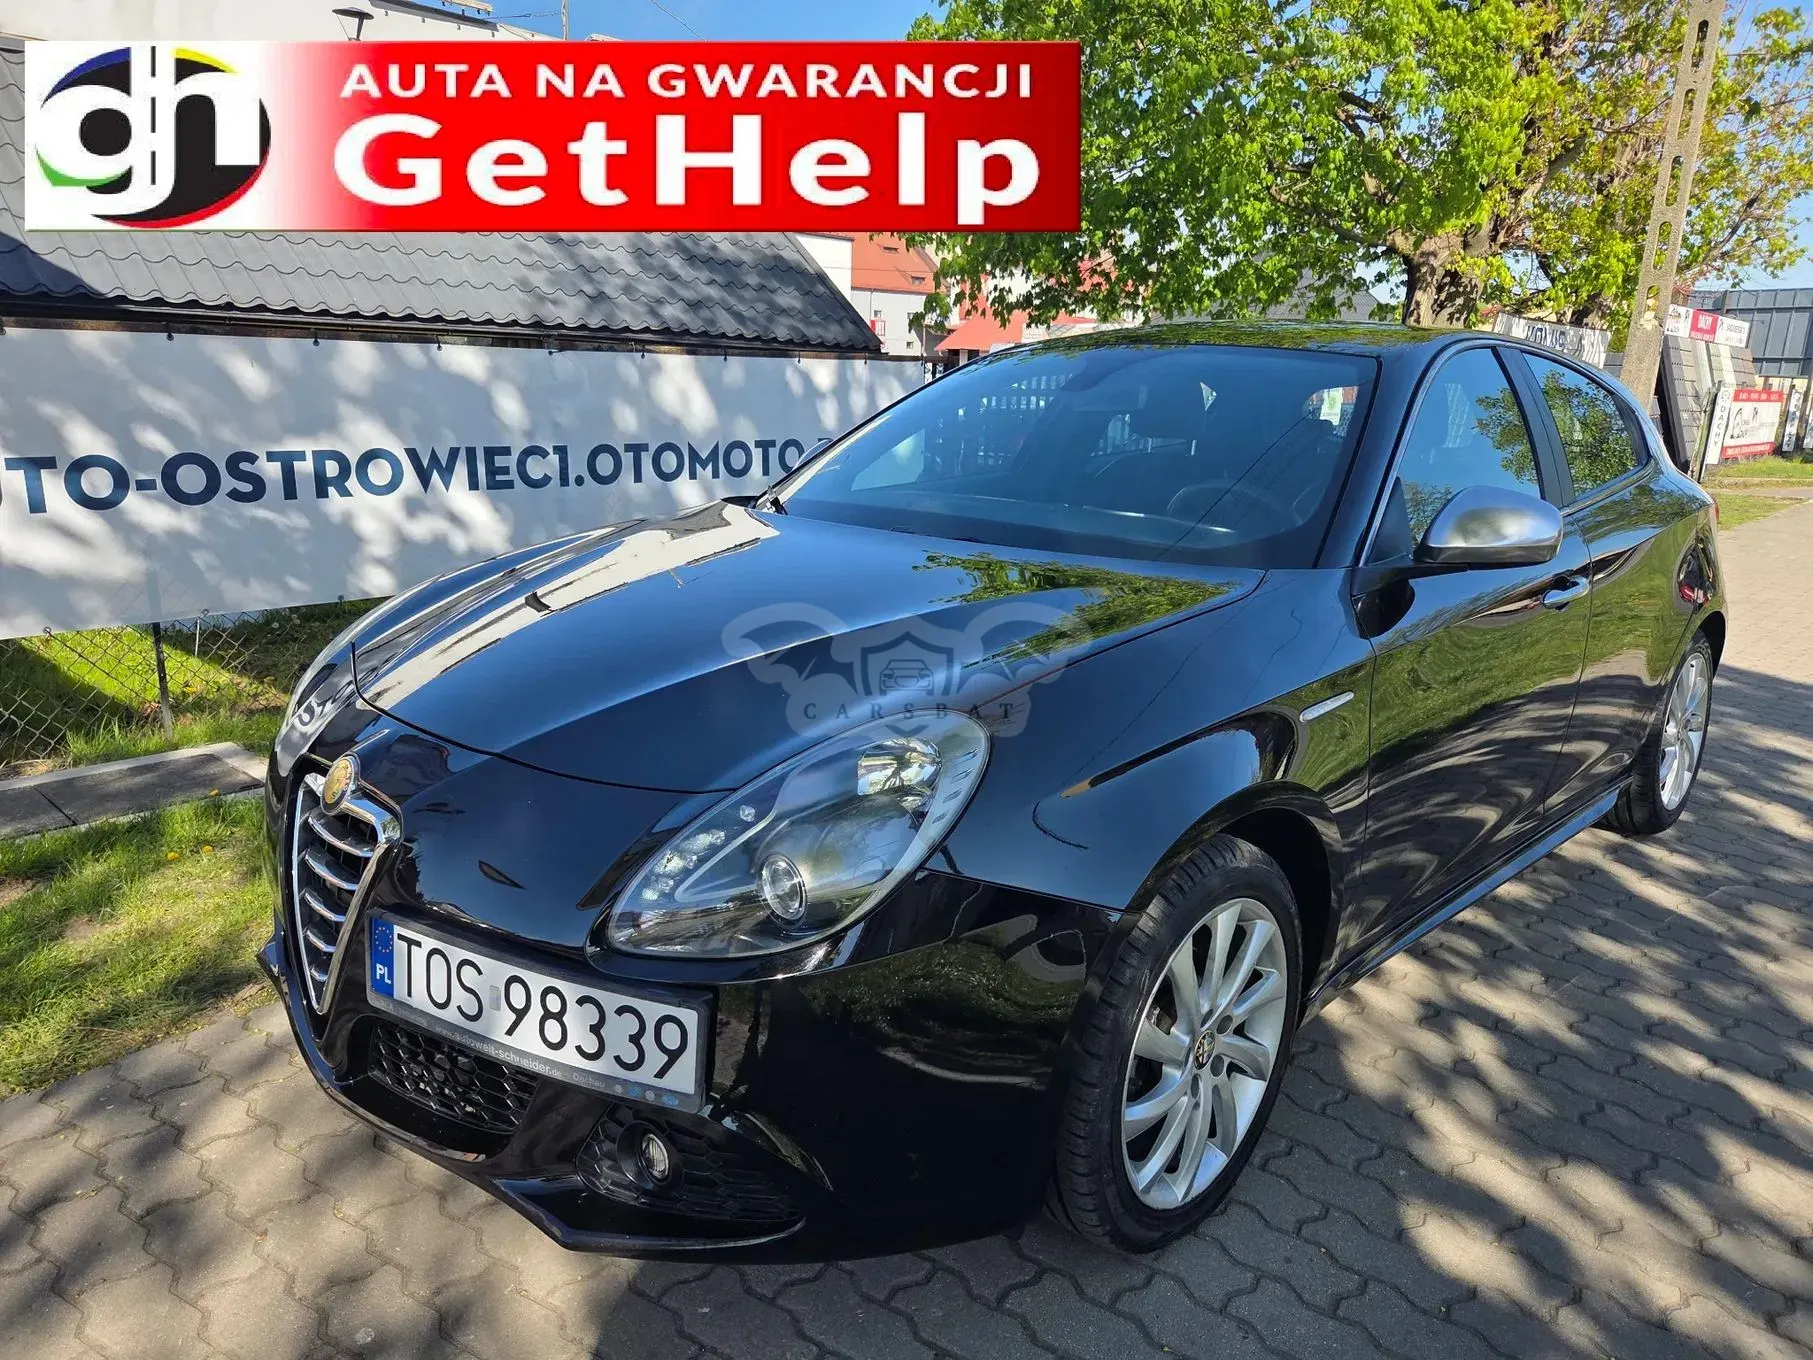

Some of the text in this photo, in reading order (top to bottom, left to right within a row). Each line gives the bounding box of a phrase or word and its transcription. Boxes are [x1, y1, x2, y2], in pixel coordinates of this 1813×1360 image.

[1713, 405, 1727, 447] DACHY
[375, 963, 392, 985] PL
[397, 932, 689, 1080] TOS 98339
